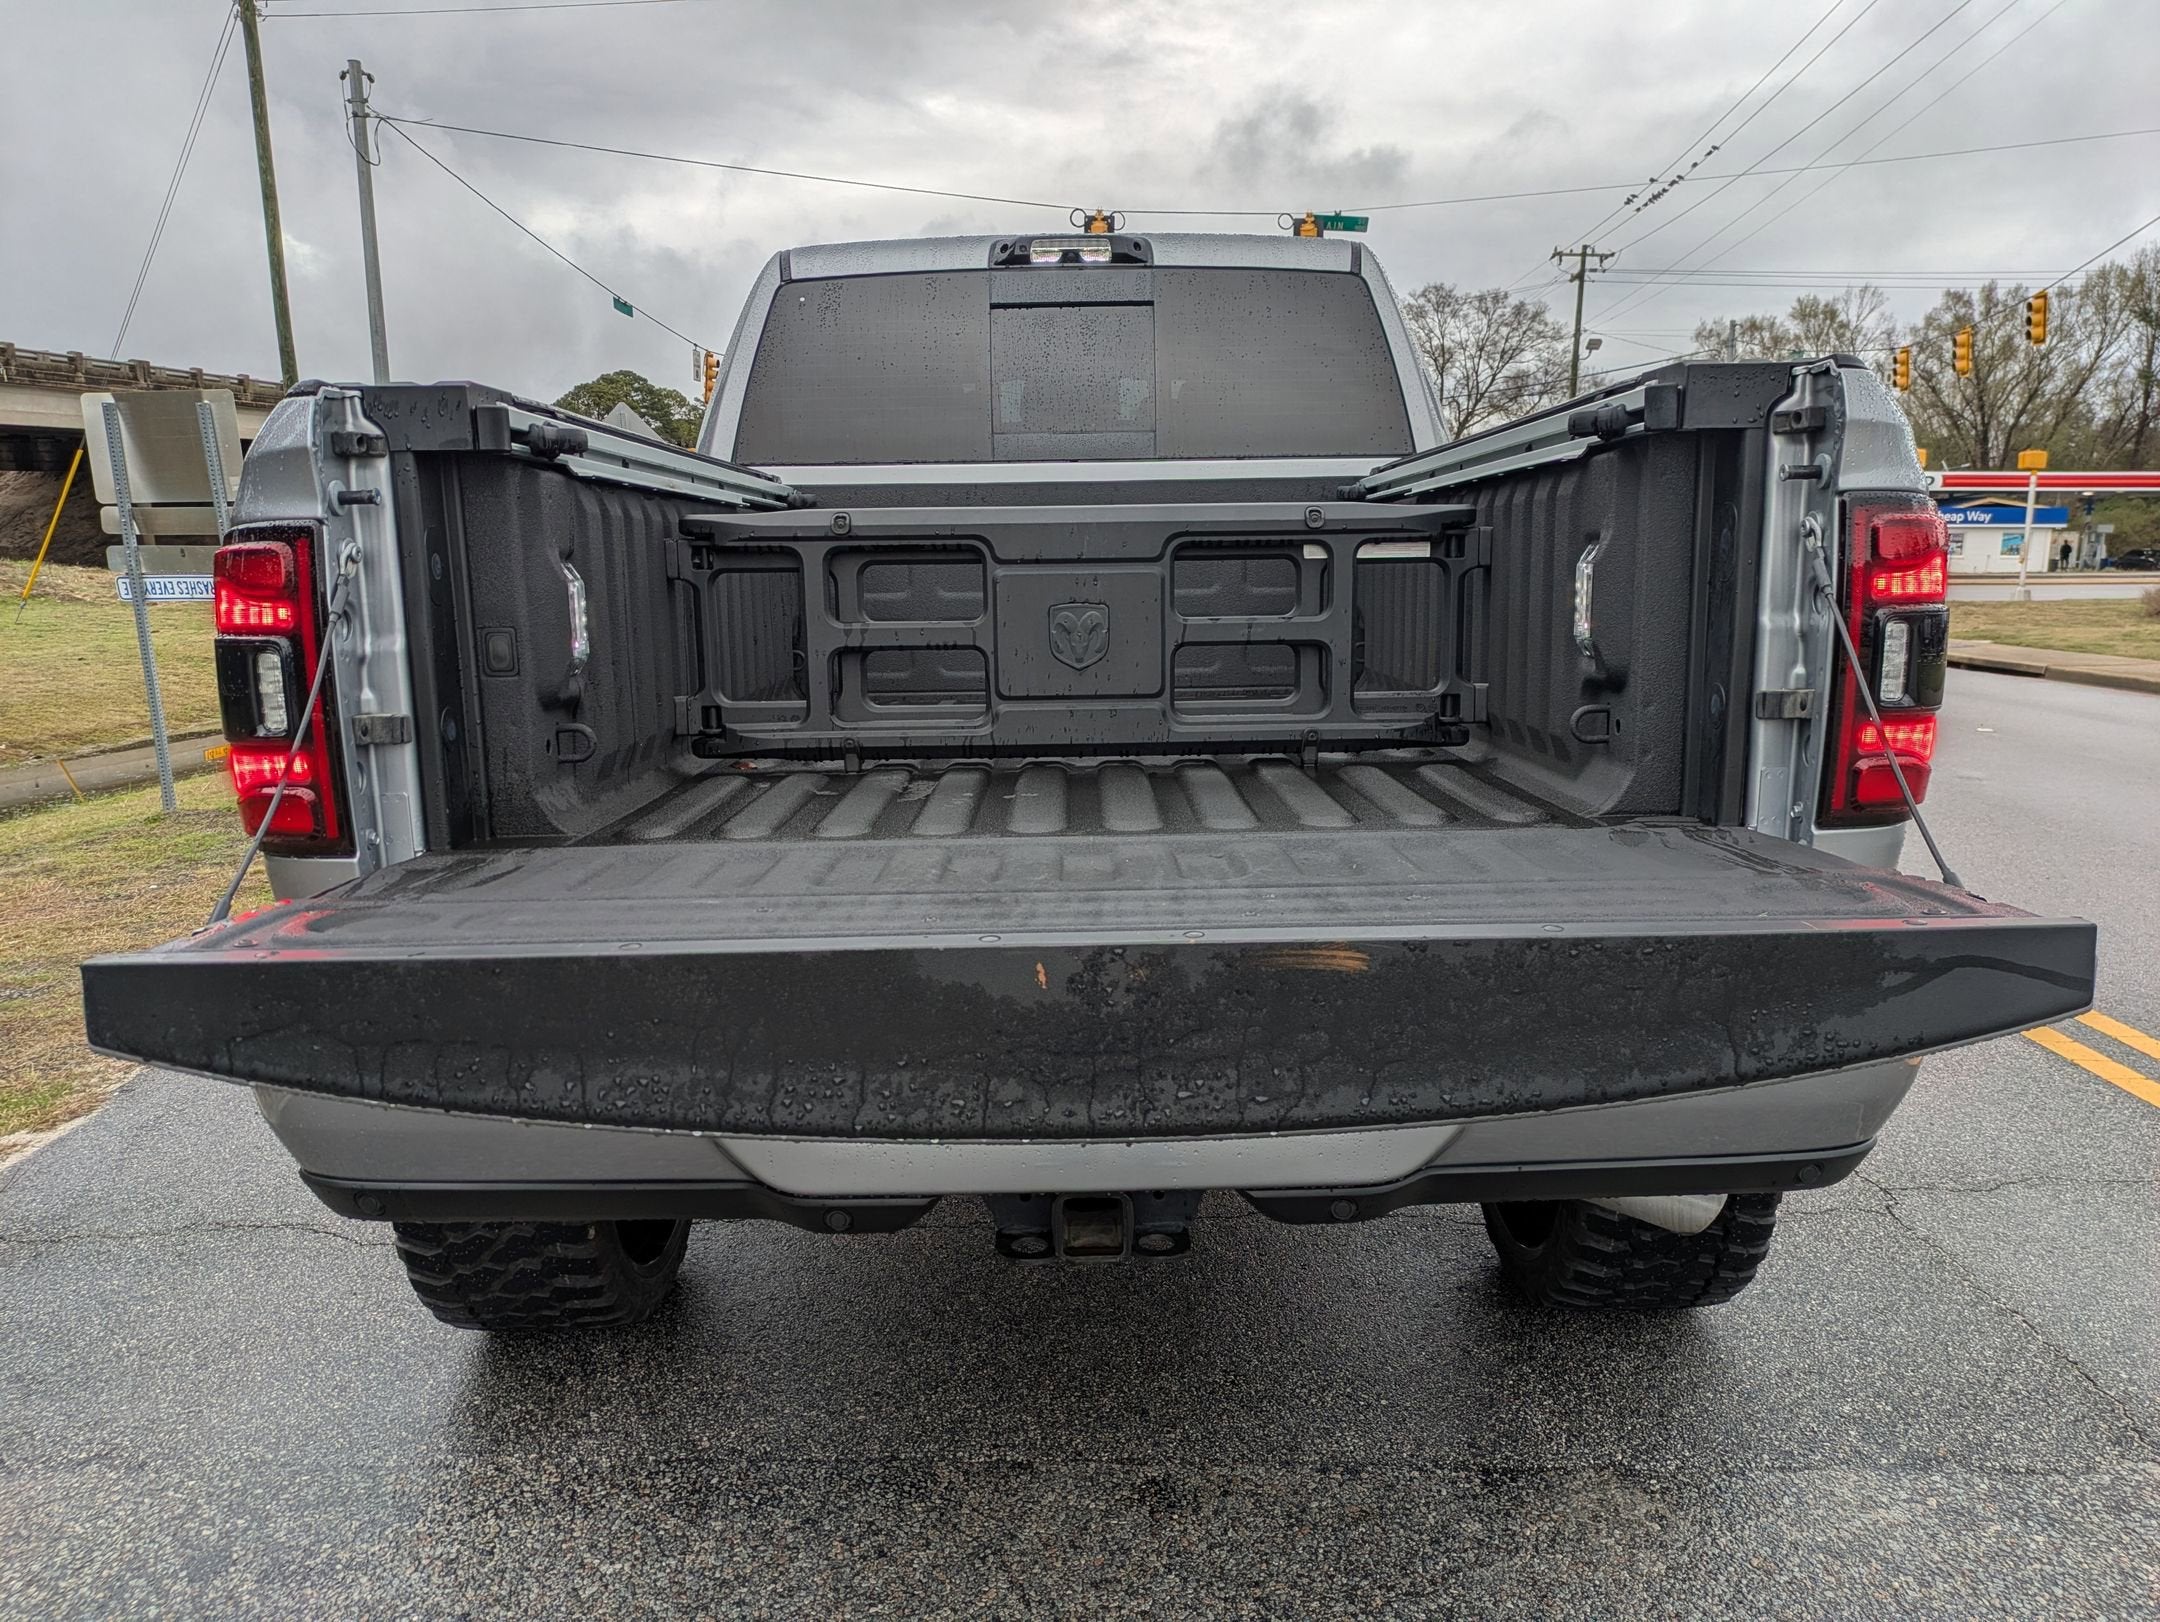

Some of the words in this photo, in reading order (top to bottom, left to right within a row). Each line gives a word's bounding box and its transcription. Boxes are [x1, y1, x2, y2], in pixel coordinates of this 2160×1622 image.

[1326, 221, 1344, 230] AIN
[1937, 511, 1965, 524] heap
[1967, 511, 1992, 524] Way
[176, 581, 215, 595] RASHES
